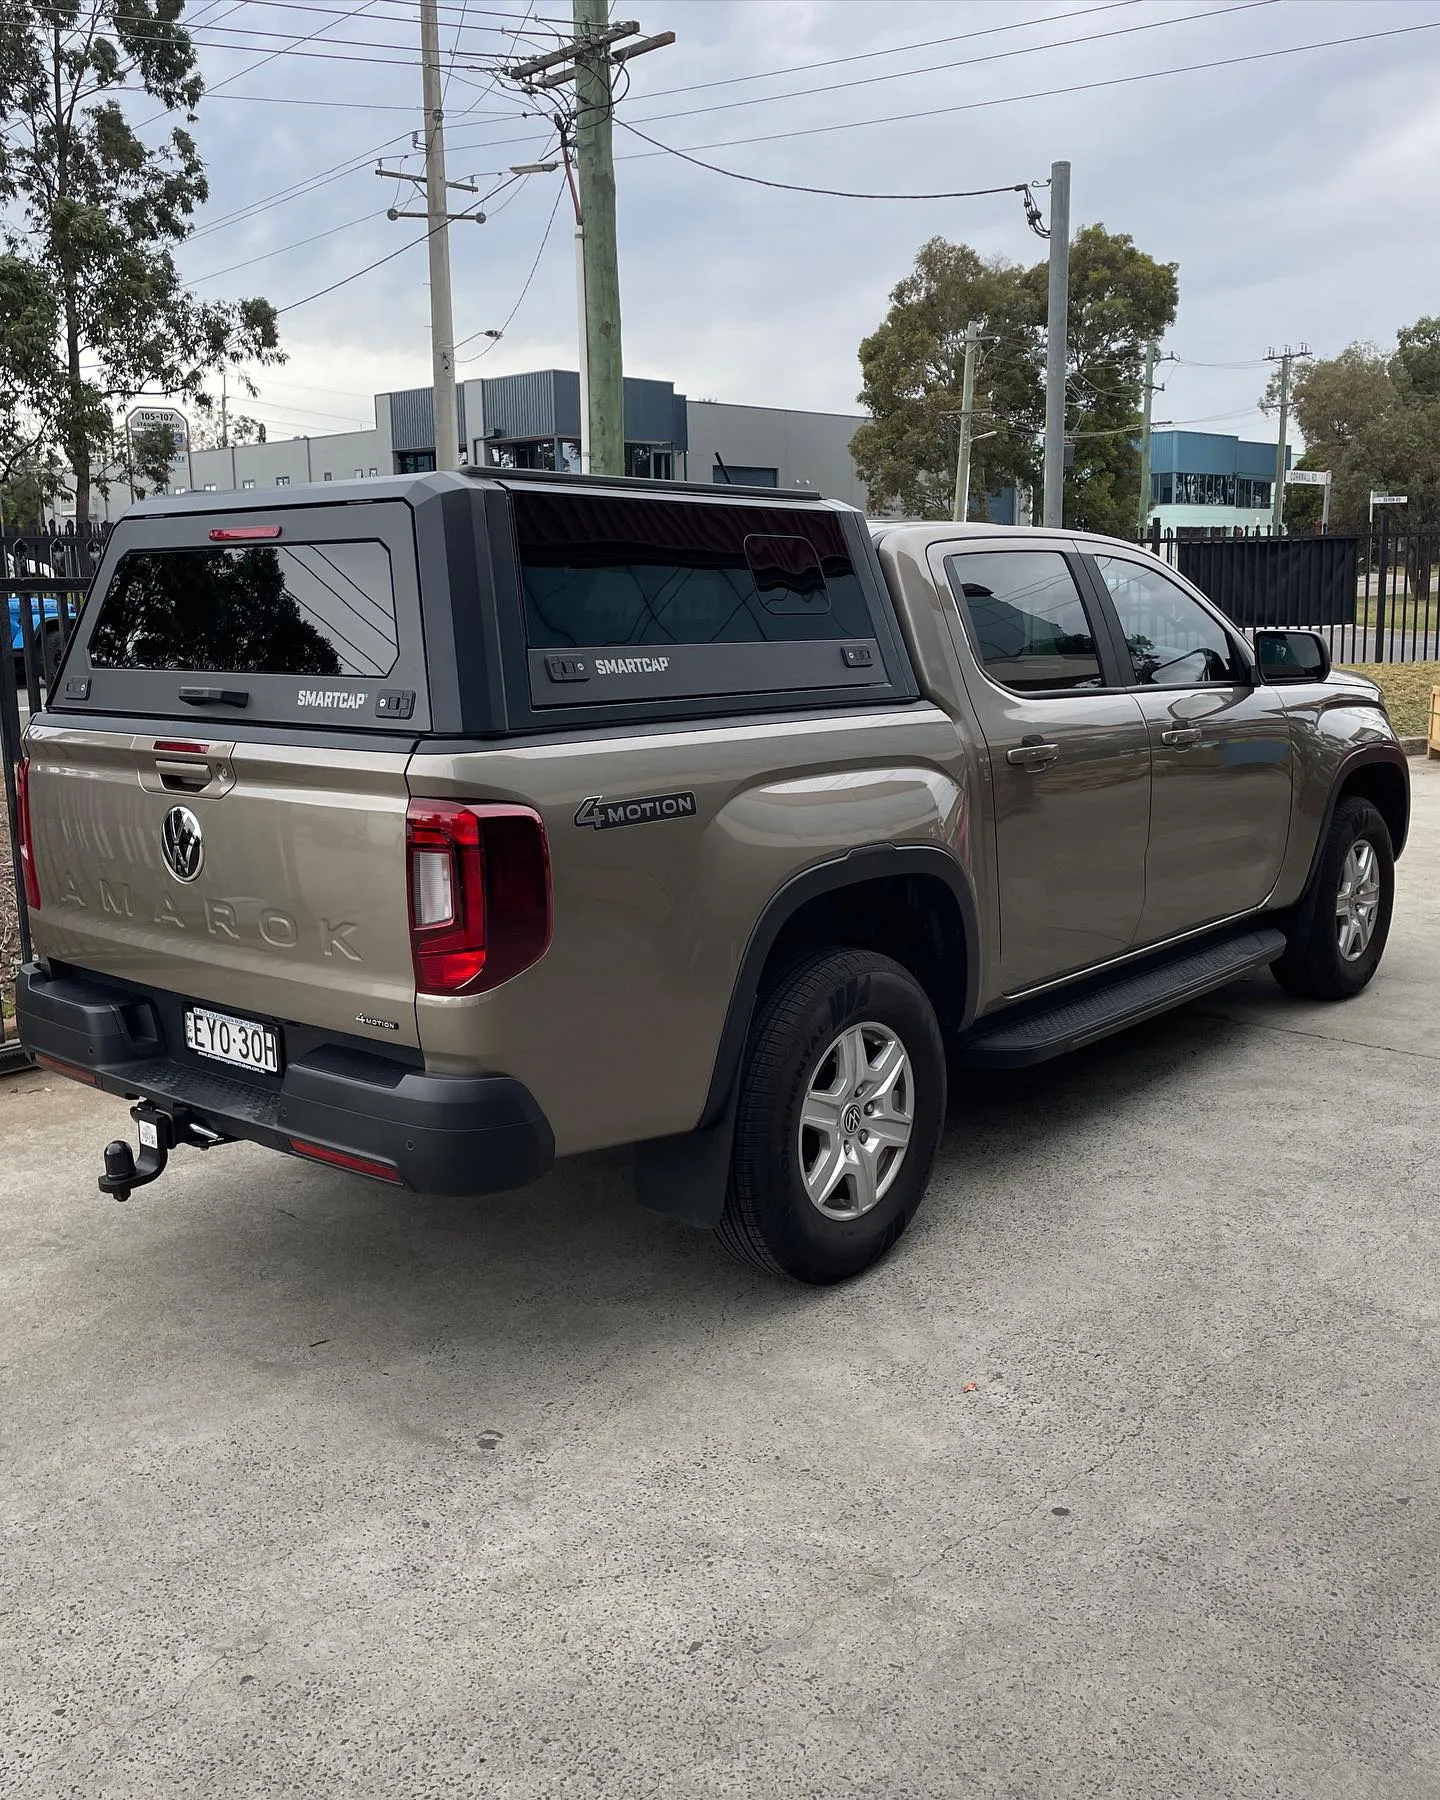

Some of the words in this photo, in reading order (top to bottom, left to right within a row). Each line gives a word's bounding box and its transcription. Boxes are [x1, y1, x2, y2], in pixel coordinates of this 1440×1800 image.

[141, 412, 174, 421] 105-107
[1290, 471, 1311, 482] CORNWALL
[1312, 473, 1318, 482] RD
[595, 656, 670, 675] SMARTCAP
[297, 689, 367, 709] SMARTCAP
[575, 794, 694, 830] 4MOTION
[60, 871, 363, 961] AMAROK
[355, 1012, 396, 1029] 4MOTION
